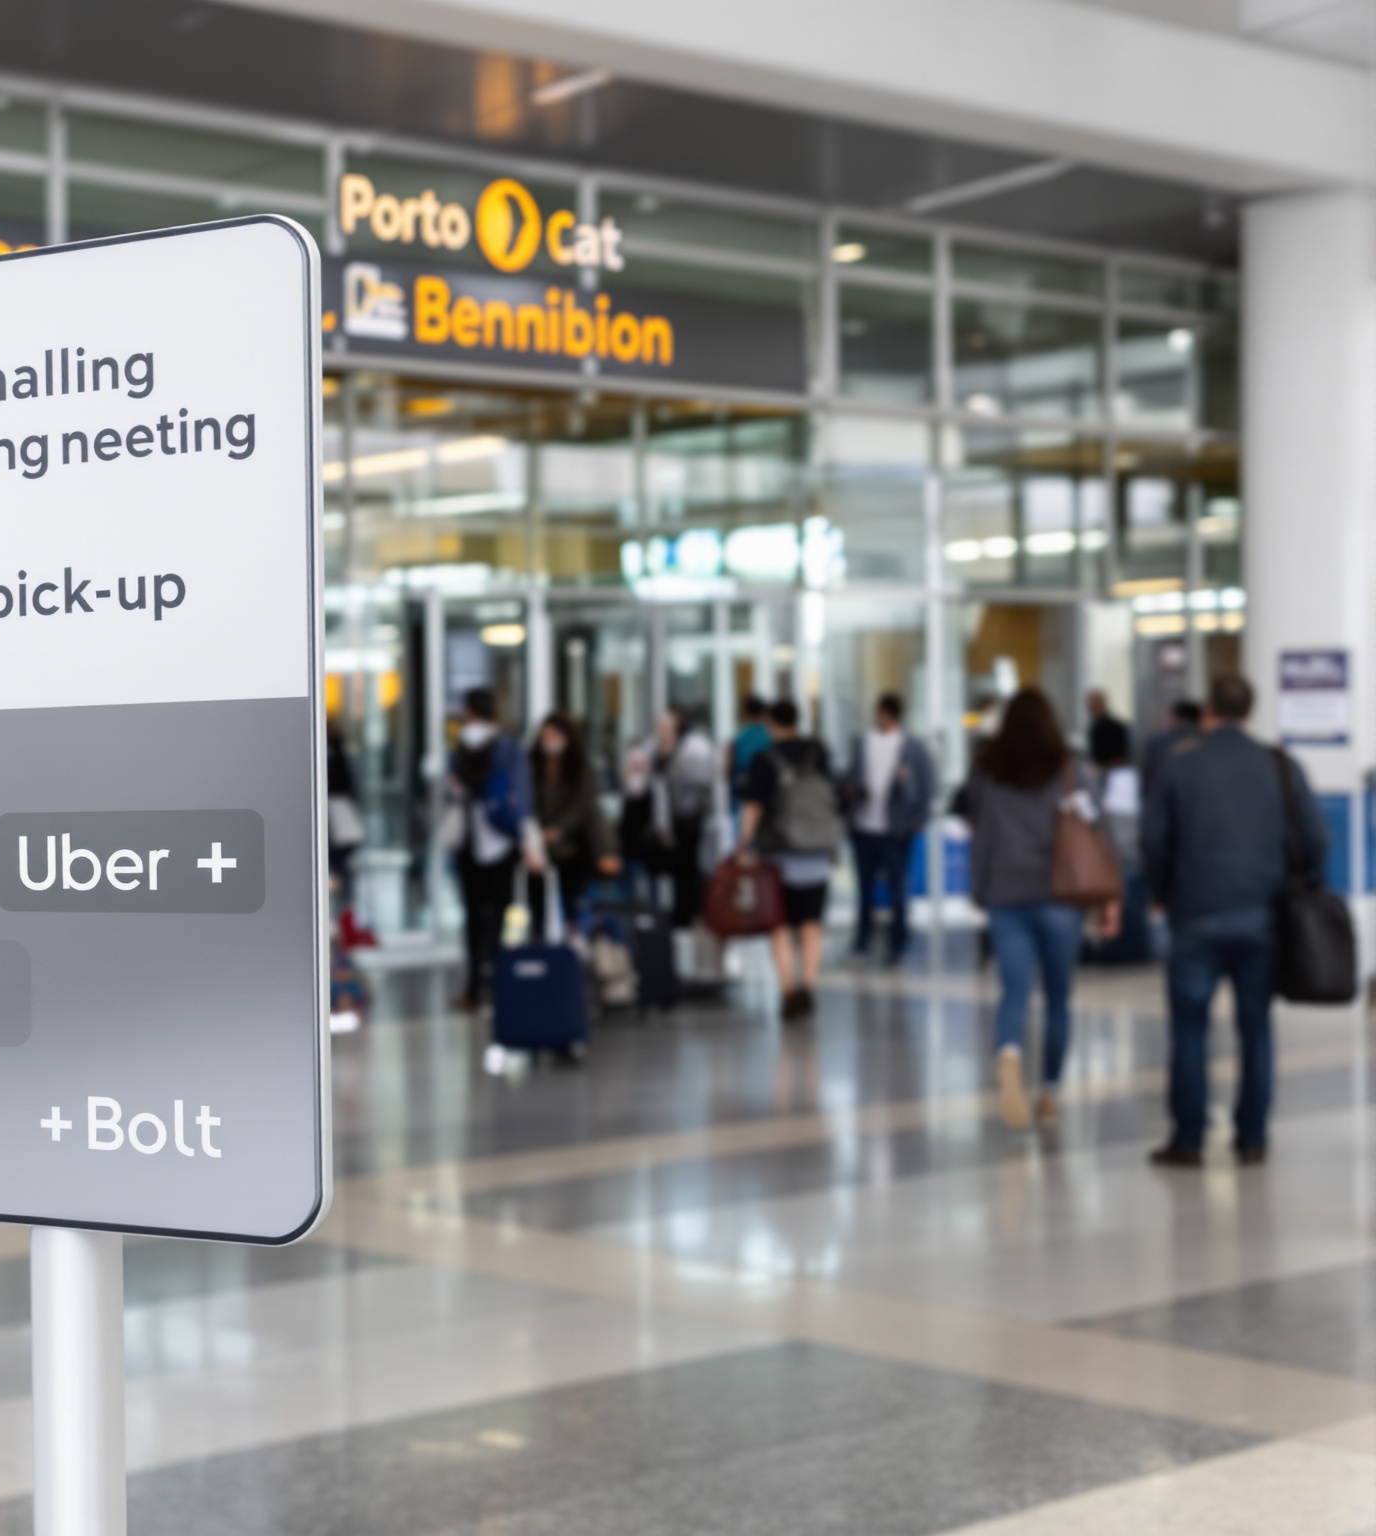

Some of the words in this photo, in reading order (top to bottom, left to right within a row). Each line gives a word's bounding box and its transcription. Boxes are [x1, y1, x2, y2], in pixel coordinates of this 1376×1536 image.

[341, 174, 470, 250] Porto
[546, 209, 624, 271] Cat
[414, 276, 673, 366] Bennibion
[61, 408, 256, 465] neeting
[18, 833, 170, 891] Uber
